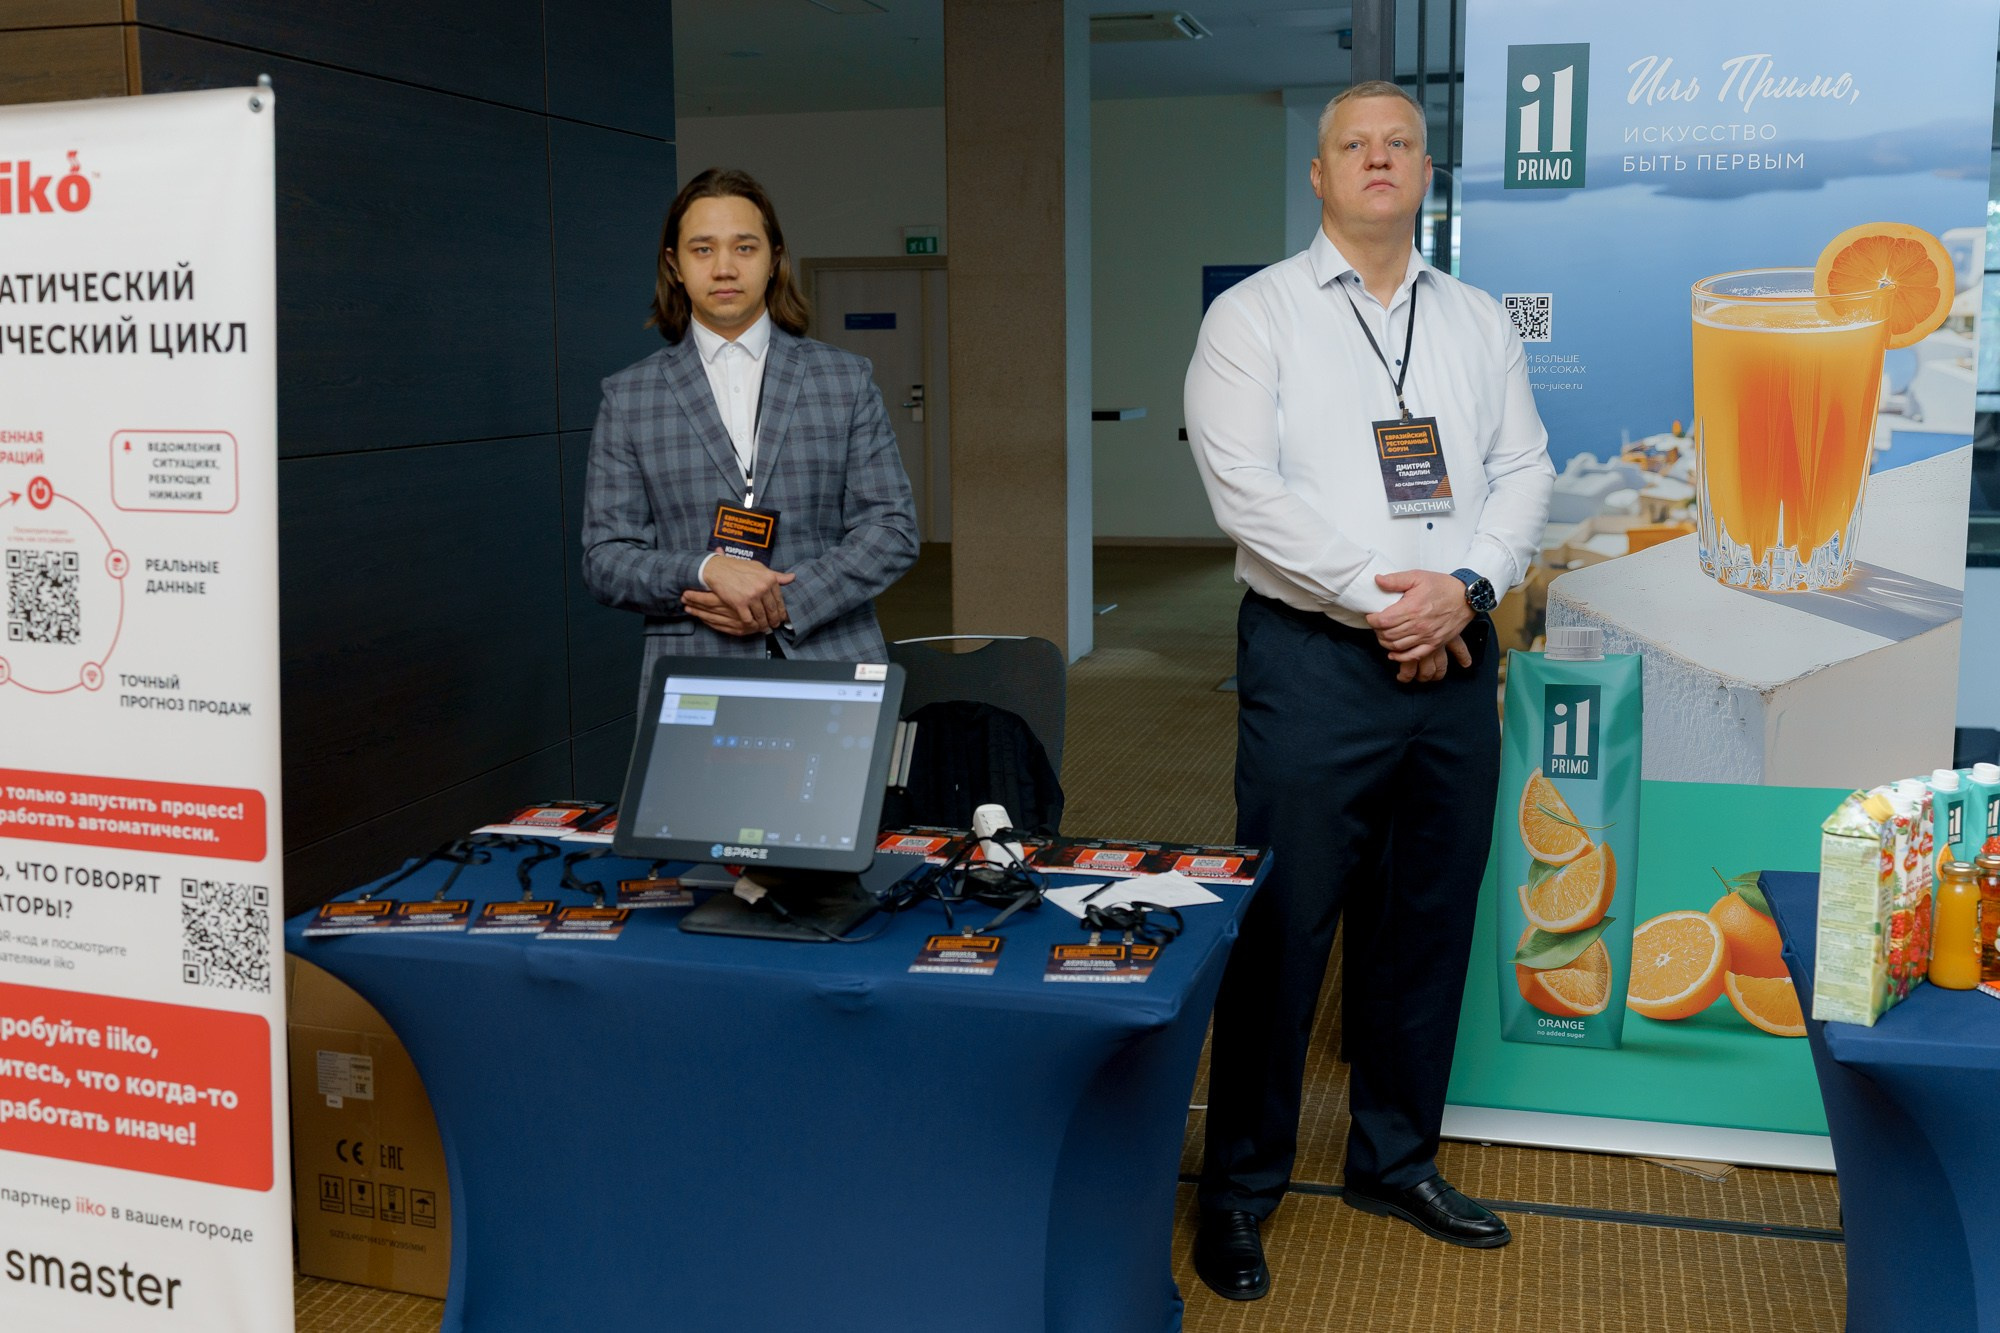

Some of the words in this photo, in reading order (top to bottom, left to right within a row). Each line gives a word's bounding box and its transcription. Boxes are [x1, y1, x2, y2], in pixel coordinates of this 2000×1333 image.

[1628, 55, 1700, 106] Иль
[1718, 53, 1860, 114] Примо,
[1624, 124, 1777, 143] ИСКУССТВО
[1517, 158, 1572, 180] PRIMO
[1623, 155, 1687, 172] БЫТЬ
[1697, 153, 1804, 170] ПЕРВЫМ
[0, 261, 194, 303] АТИЧЕСКИЙ
[0, 315, 137, 354] ЧЕСКИЙ
[151, 322, 247, 359] ЦИКЛ
[1535, 355, 1580, 363] БОЛЬШЕ
[1550, 366, 1586, 374] СОКАХ
[0, 430, 44, 443] ЕННАЯ
[1396, 461, 1431, 471] ДМИТРИЙ
[1393, 500, 1452, 514] УЧАСТНИК
[146, 558, 220, 574] РЕАЛЬНЫЕ
[146, 580, 206, 594] ДАННЫЕ
[120, 674, 180, 690] ТОЧНЫЙ
[121, 695, 184, 711] ПРОГНОЗ
[188, 700, 252, 715] ПРОДАЖ
[1551, 758, 1589, 774] PRIMO
[6, 786, 66, 804] только
[70, 792, 157, 812] запустить
[161, 800, 244, 820] процесс!
[78, 816, 219, 842] автоматически.
[16, 861, 58, 882] ЧТО
[65, 866, 161, 894] ГОВОРЯТ
[41, 937, 49, 946] и
[51, 939, 127, 958] посмотрите
[1537, 1018, 1585, 1030] ORANGE
[0, 1016, 101, 1048] робуйте
[106, 1025, 158, 1059] iiko,
[76, 1069, 120, 1092] что
[126, 1076, 238, 1110] когда-то
[0, 1098, 110, 1133] работать
[115, 1117, 196, 1147] иначе!
[1, 1187, 71, 1214] партнер
[75, 1196, 107, 1217] iiko
[111, 1207, 120, 1219] в
[126, 1208, 183, 1230] вашем
[189, 1218, 254, 1243] городе
[6, 1249, 182, 1310] smaster
